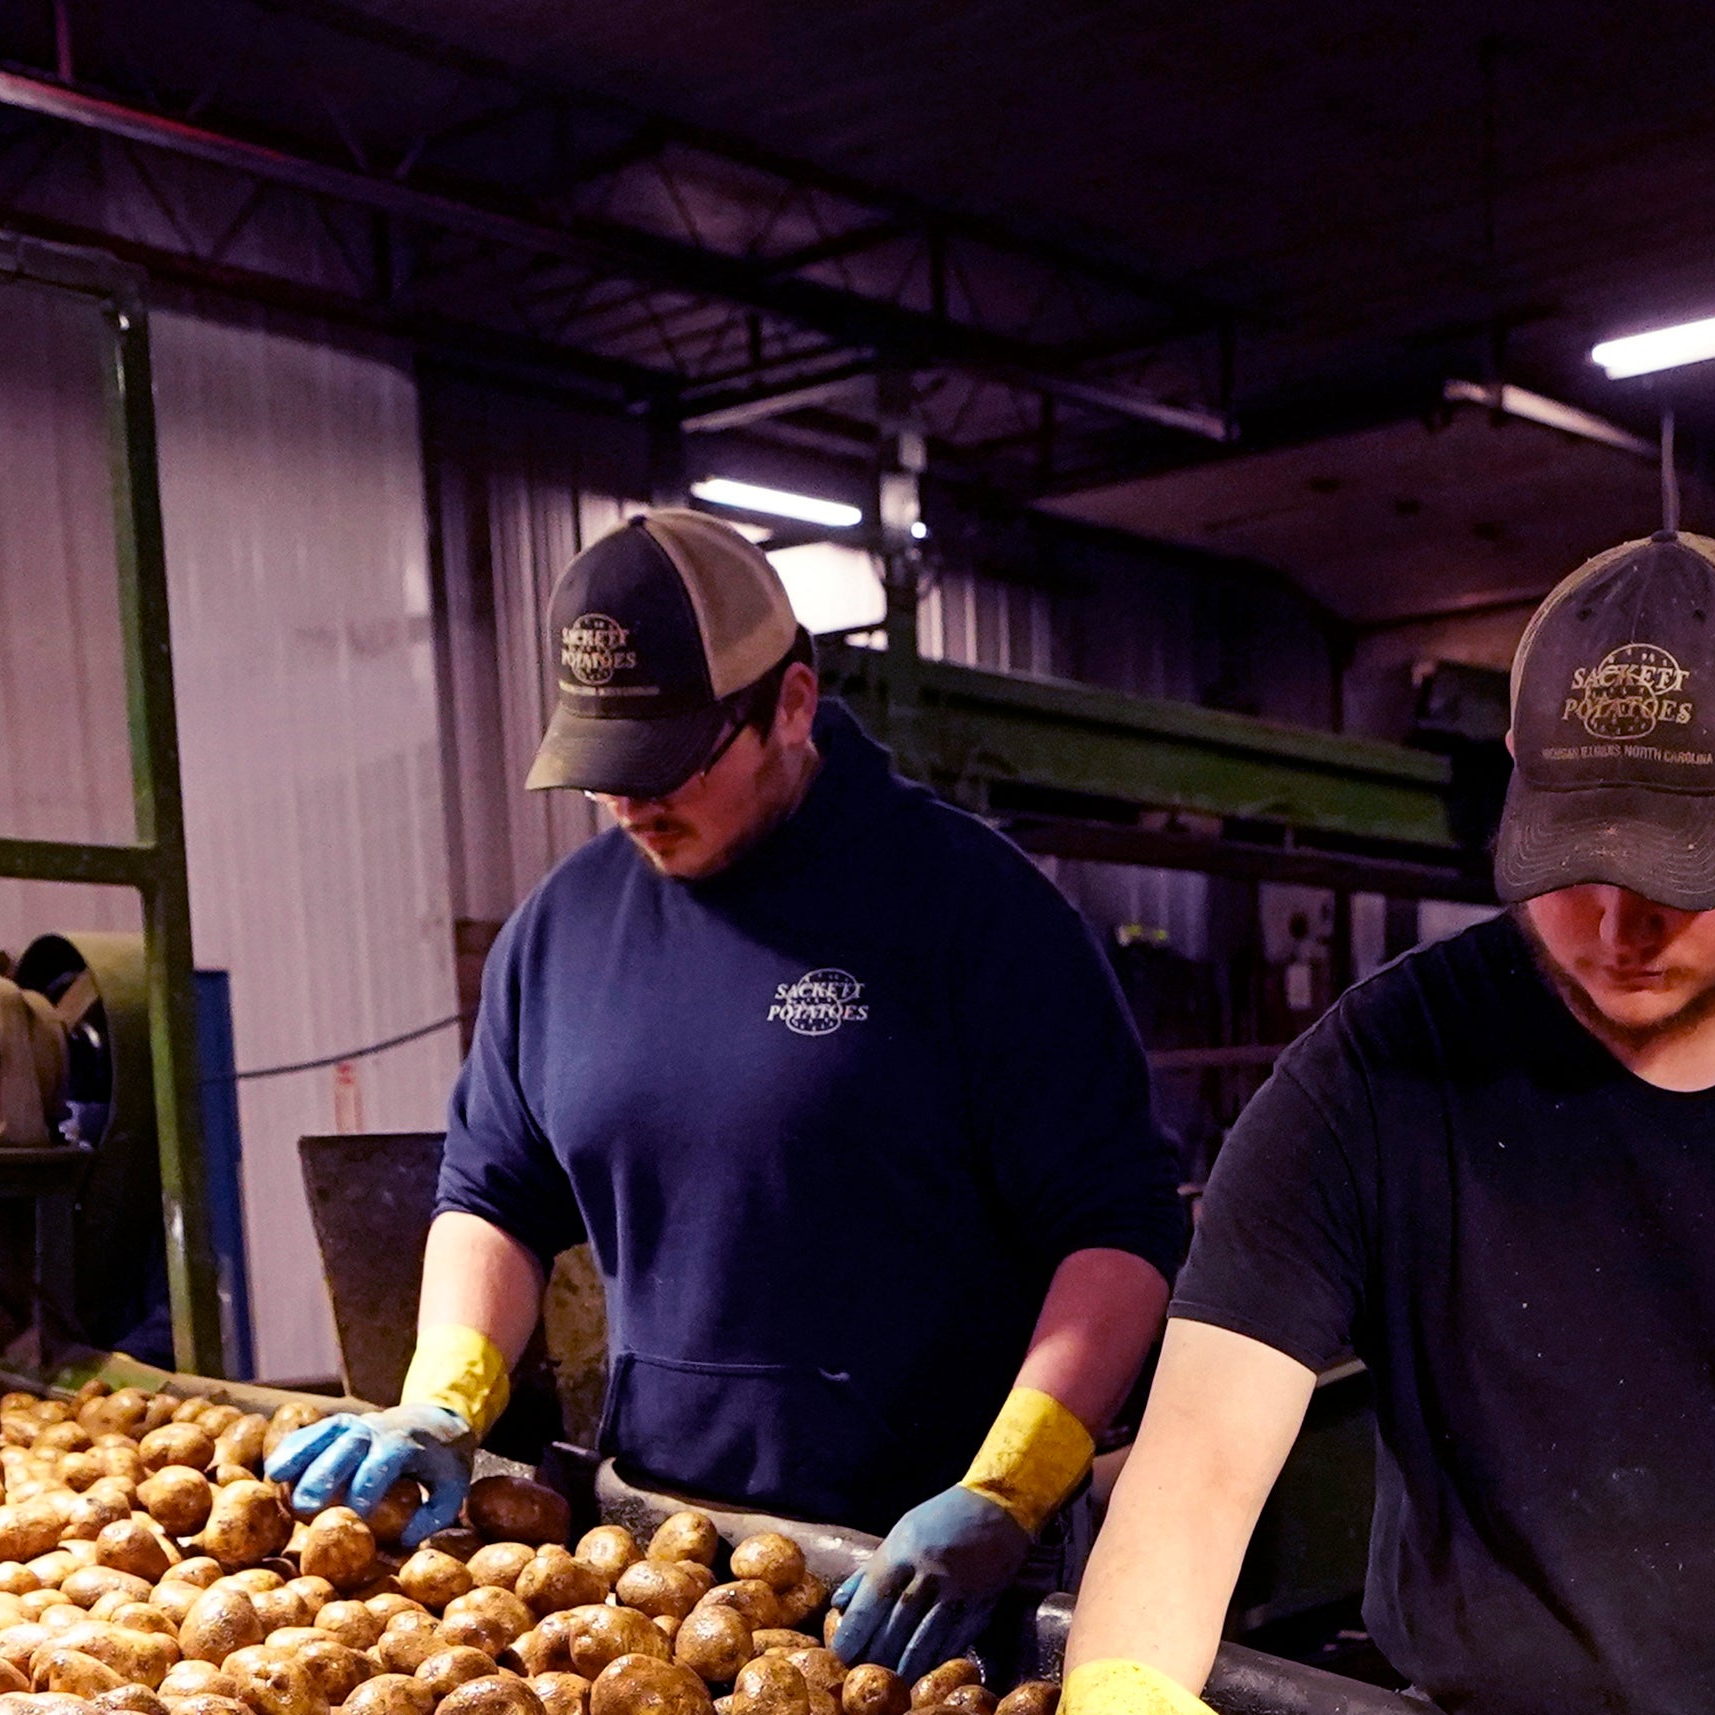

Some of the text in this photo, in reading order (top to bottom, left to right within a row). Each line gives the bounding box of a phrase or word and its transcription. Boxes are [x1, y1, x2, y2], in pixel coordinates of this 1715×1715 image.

[1571, 664, 1689, 691] SACKETT
[1561, 697, 1693, 724] POTATOES
[1624, 745, 1662, 761] NORTH
[1663, 751, 1714, 765] CAROLINA
[774, 983, 865, 999] SACKETT
[766, 1004, 869, 1022] POTATOES
